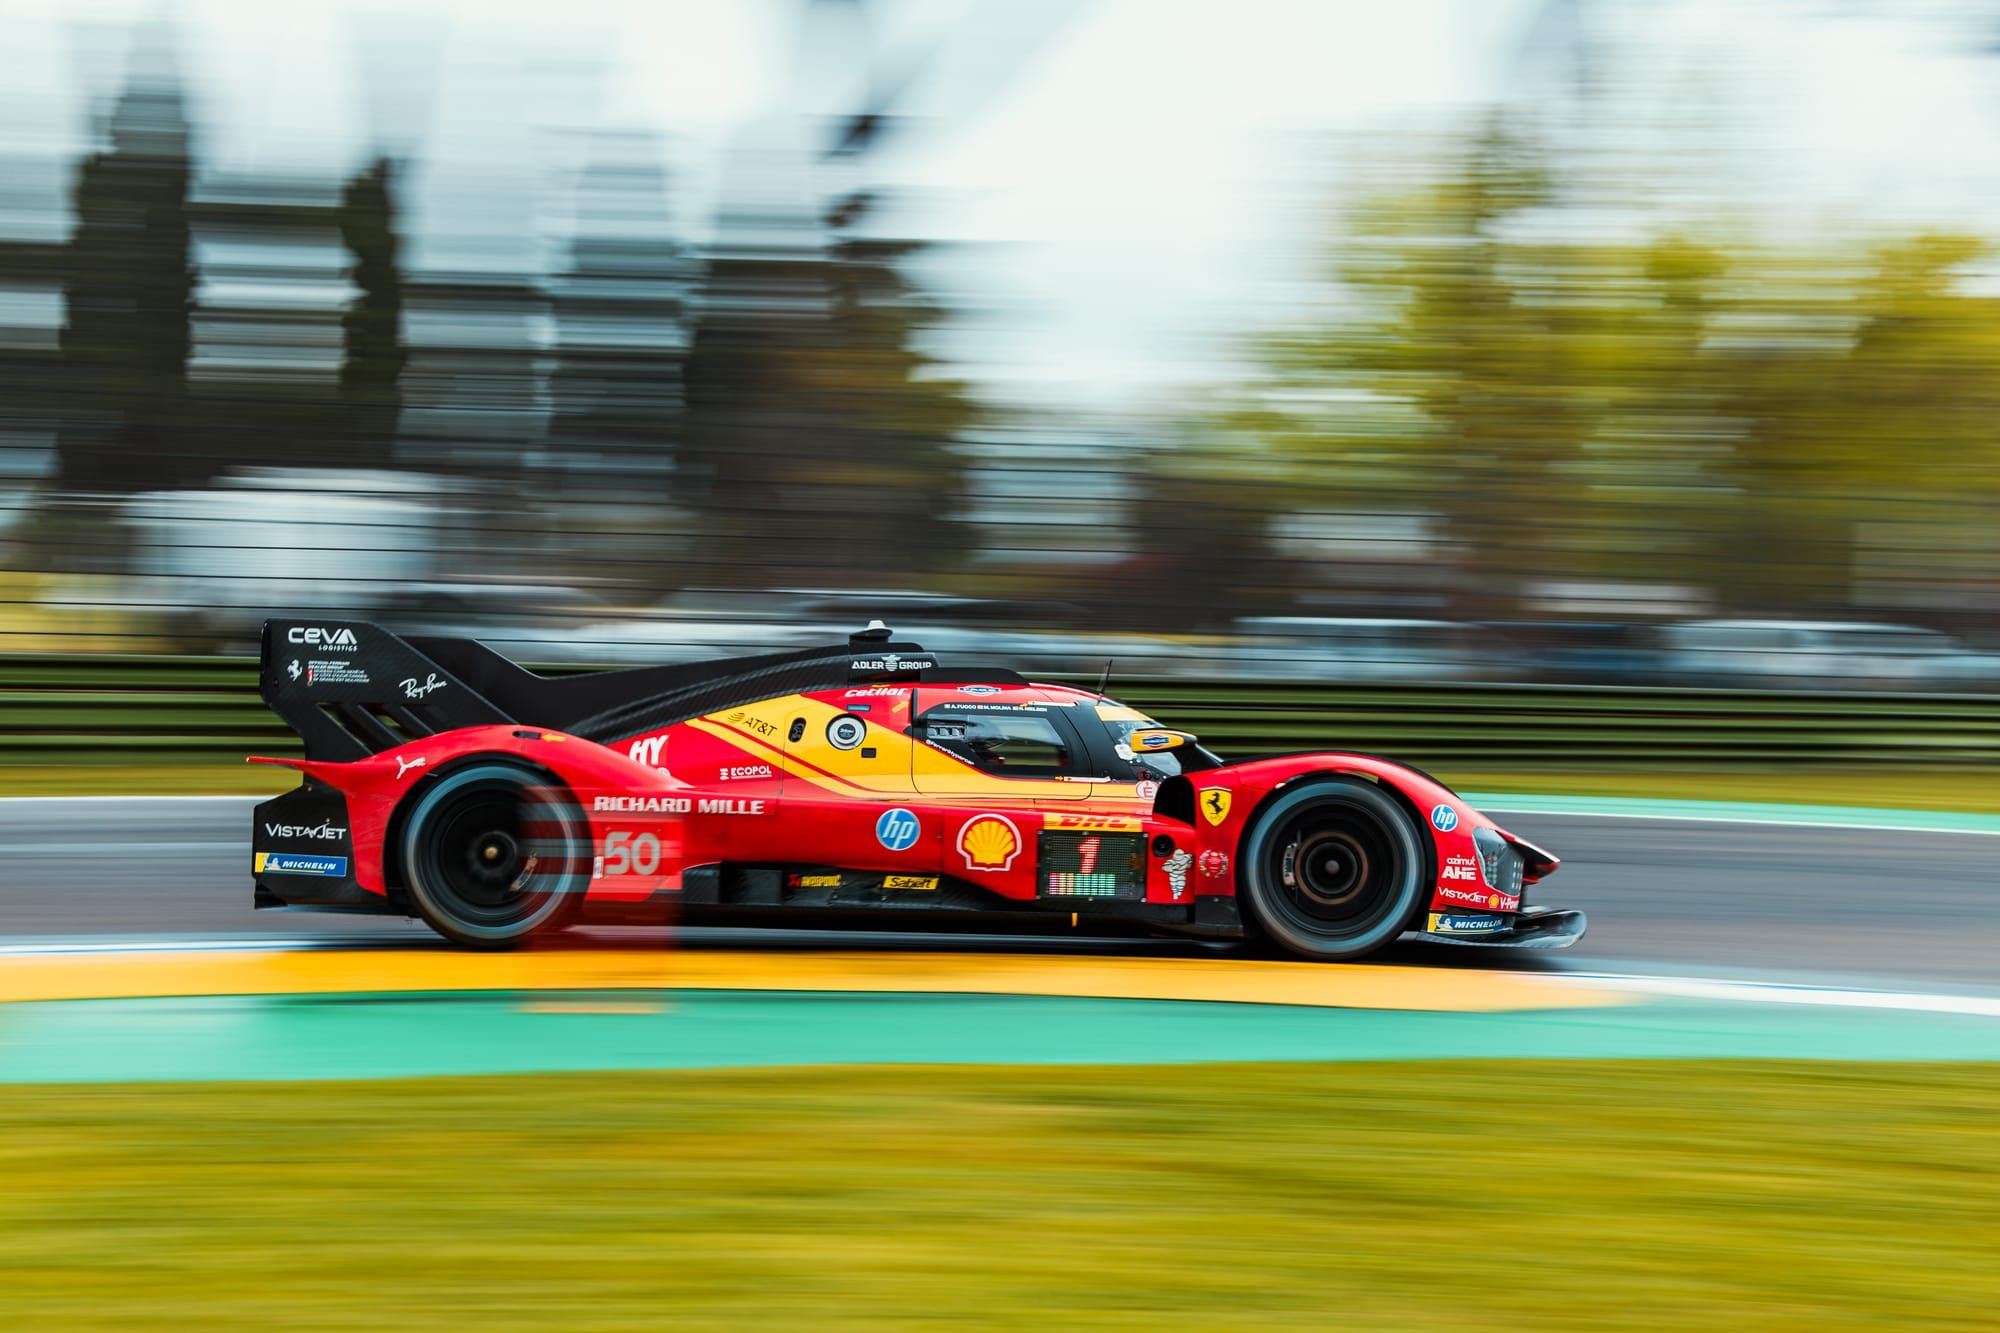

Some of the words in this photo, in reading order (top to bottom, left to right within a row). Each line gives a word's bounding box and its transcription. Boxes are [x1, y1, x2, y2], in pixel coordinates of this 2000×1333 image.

[851, 661, 884, 669] ADLER
[899, 661, 932, 670] GROUP
[398, 673, 448, 699] Ray-Ban
[744, 717, 778, 736] AT&T
[730, 765, 772, 776] ECOPOL
[1143, 786, 1153, 798] E
[593, 796, 691, 813] RICHARD
[698, 799, 765, 815] MILLE
[1060, 816, 1128, 829] DHL
[1435, 806, 1455, 831] hp
[882, 809, 918, 850] hp
[605, 831, 661, 875] 50
[1077, 835, 1100, 875] 1
[1446, 854, 1476, 866] azimut
[282, 860, 337, 871] MICHELIN
[1441, 866, 1477, 880] AHE
[1454, 919, 1502, 929] MICHELIN
